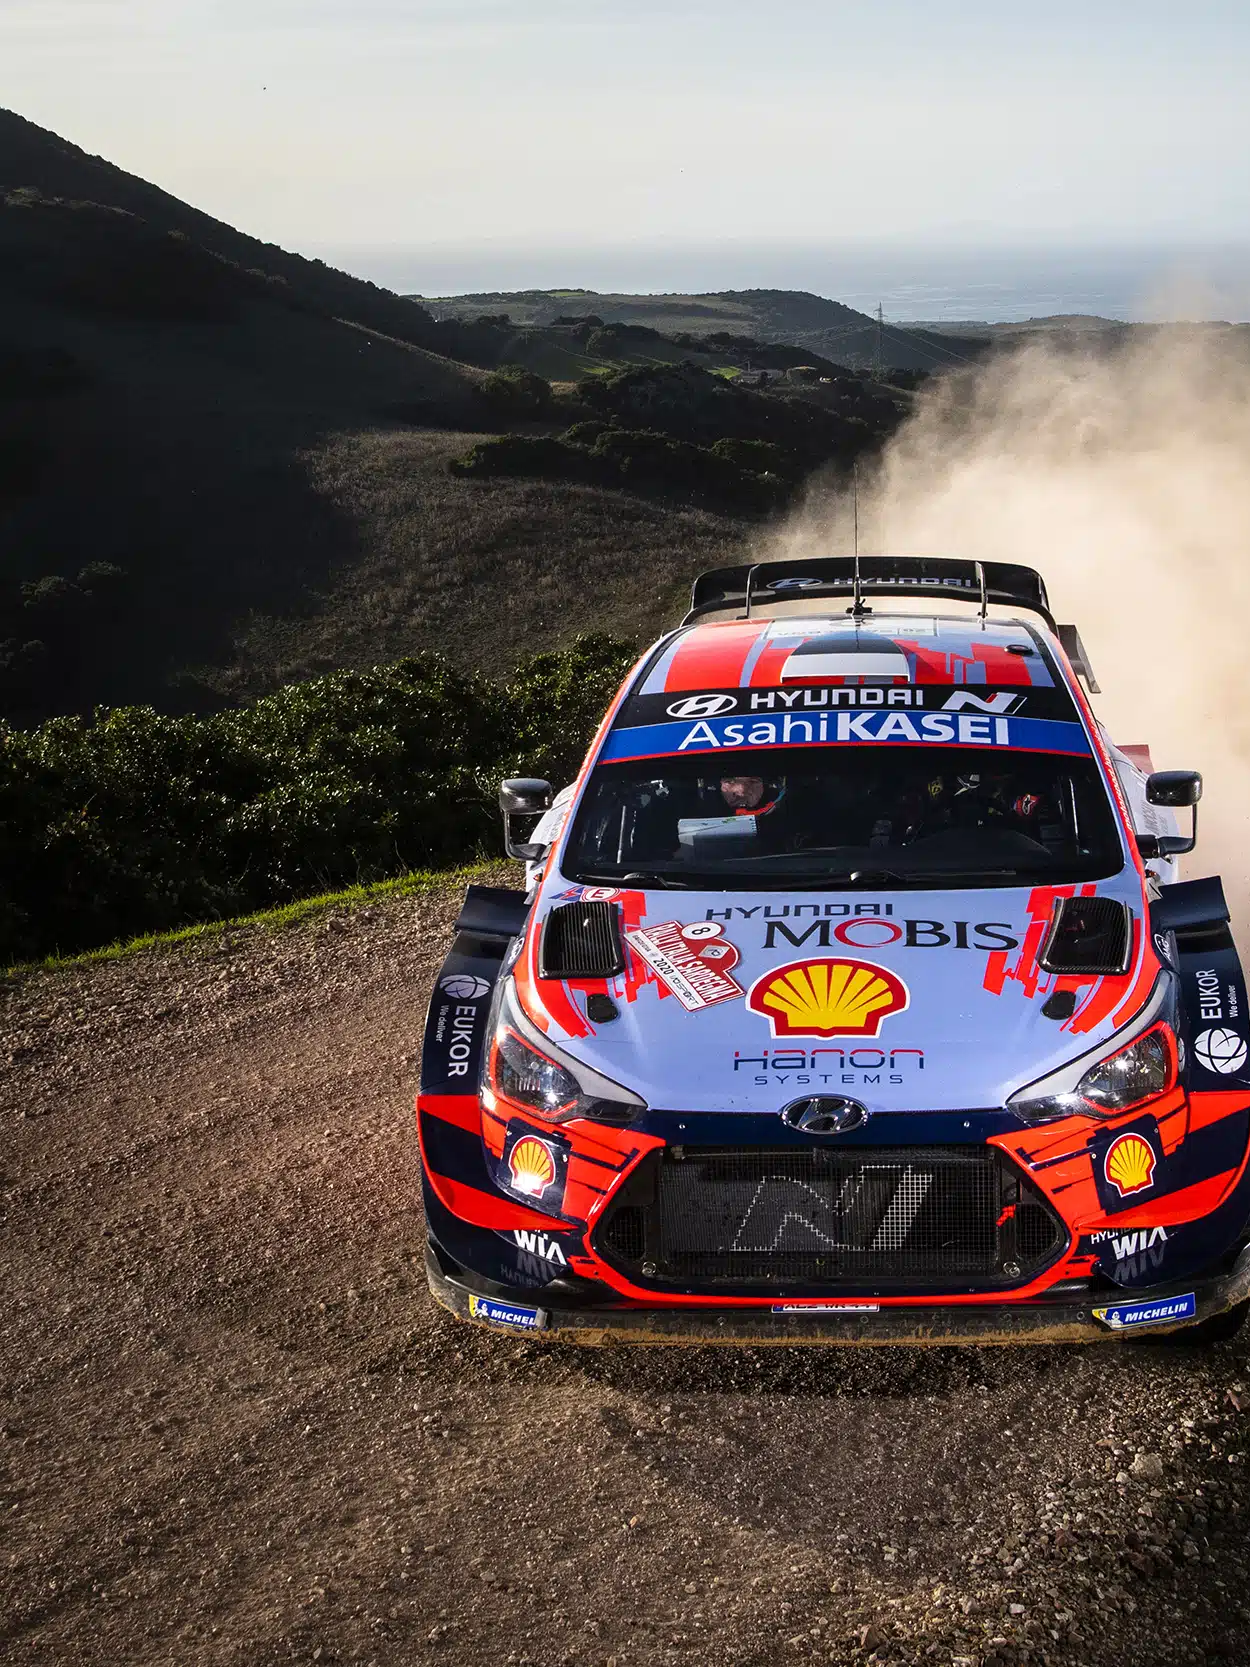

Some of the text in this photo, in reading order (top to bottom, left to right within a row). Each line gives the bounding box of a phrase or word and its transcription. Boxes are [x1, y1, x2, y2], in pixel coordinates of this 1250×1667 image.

[833, 577, 971, 587] HYUNDAI
[750, 689, 924, 709] HYUNDAI
[591, 888, 611, 898] E
[705, 904, 893, 920] HYUNDAI
[691, 927, 711, 935] 8
[761, 917, 1019, 951] MOBIS
[643, 923, 738, 1001] RALLY ITALIA SARDEGNA
[652, 957, 674, 975] 2020
[1196, 969, 1222, 1020] EUKOR
[1228, 985, 1239, 1018] We deliver
[436, 1005, 449, 1042] We deliver
[448, 1005, 477, 1077] EUKOR
[755, 1074, 903, 1085] SYSTEMS
[513, 1229, 568, 1266] WIA
[1112, 1226, 1168, 1260] WIA
[491, 1309, 537, 1326] MICHEL
[1125, 1303, 1188, 1322] MICHELIN
